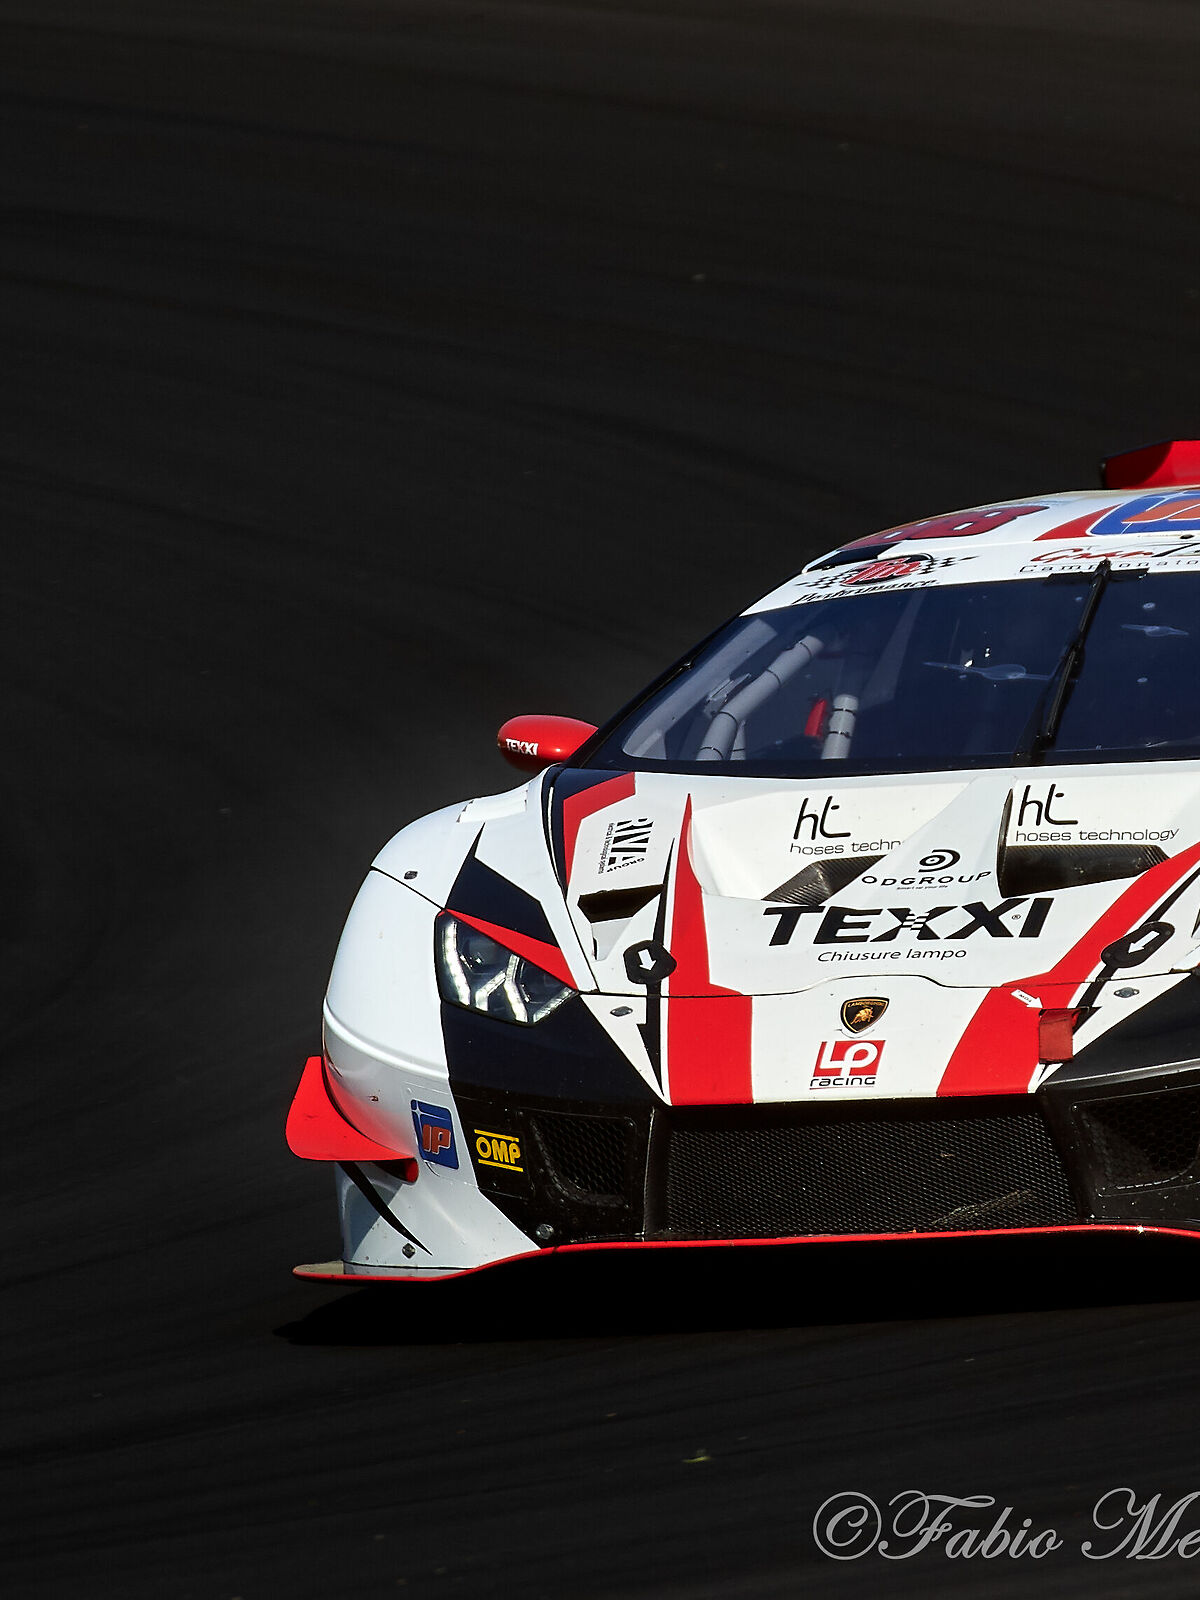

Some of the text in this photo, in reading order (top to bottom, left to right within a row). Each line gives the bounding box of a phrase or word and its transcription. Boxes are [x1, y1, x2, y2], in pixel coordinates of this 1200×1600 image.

[505, 738, 539, 756] TEXXI
[1017, 783, 1079, 827] ht
[792, 795, 852, 841] ht
[1016, 827, 1180, 843] hoses technology
[789, 843, 845, 856] hoses
[762, 897, 1054, 946] TEXXI
[817, 946, 968, 963] Chiusure lampo
[809, 1076, 876, 1087] racing
[475, 1136, 521, 1165] OMP
